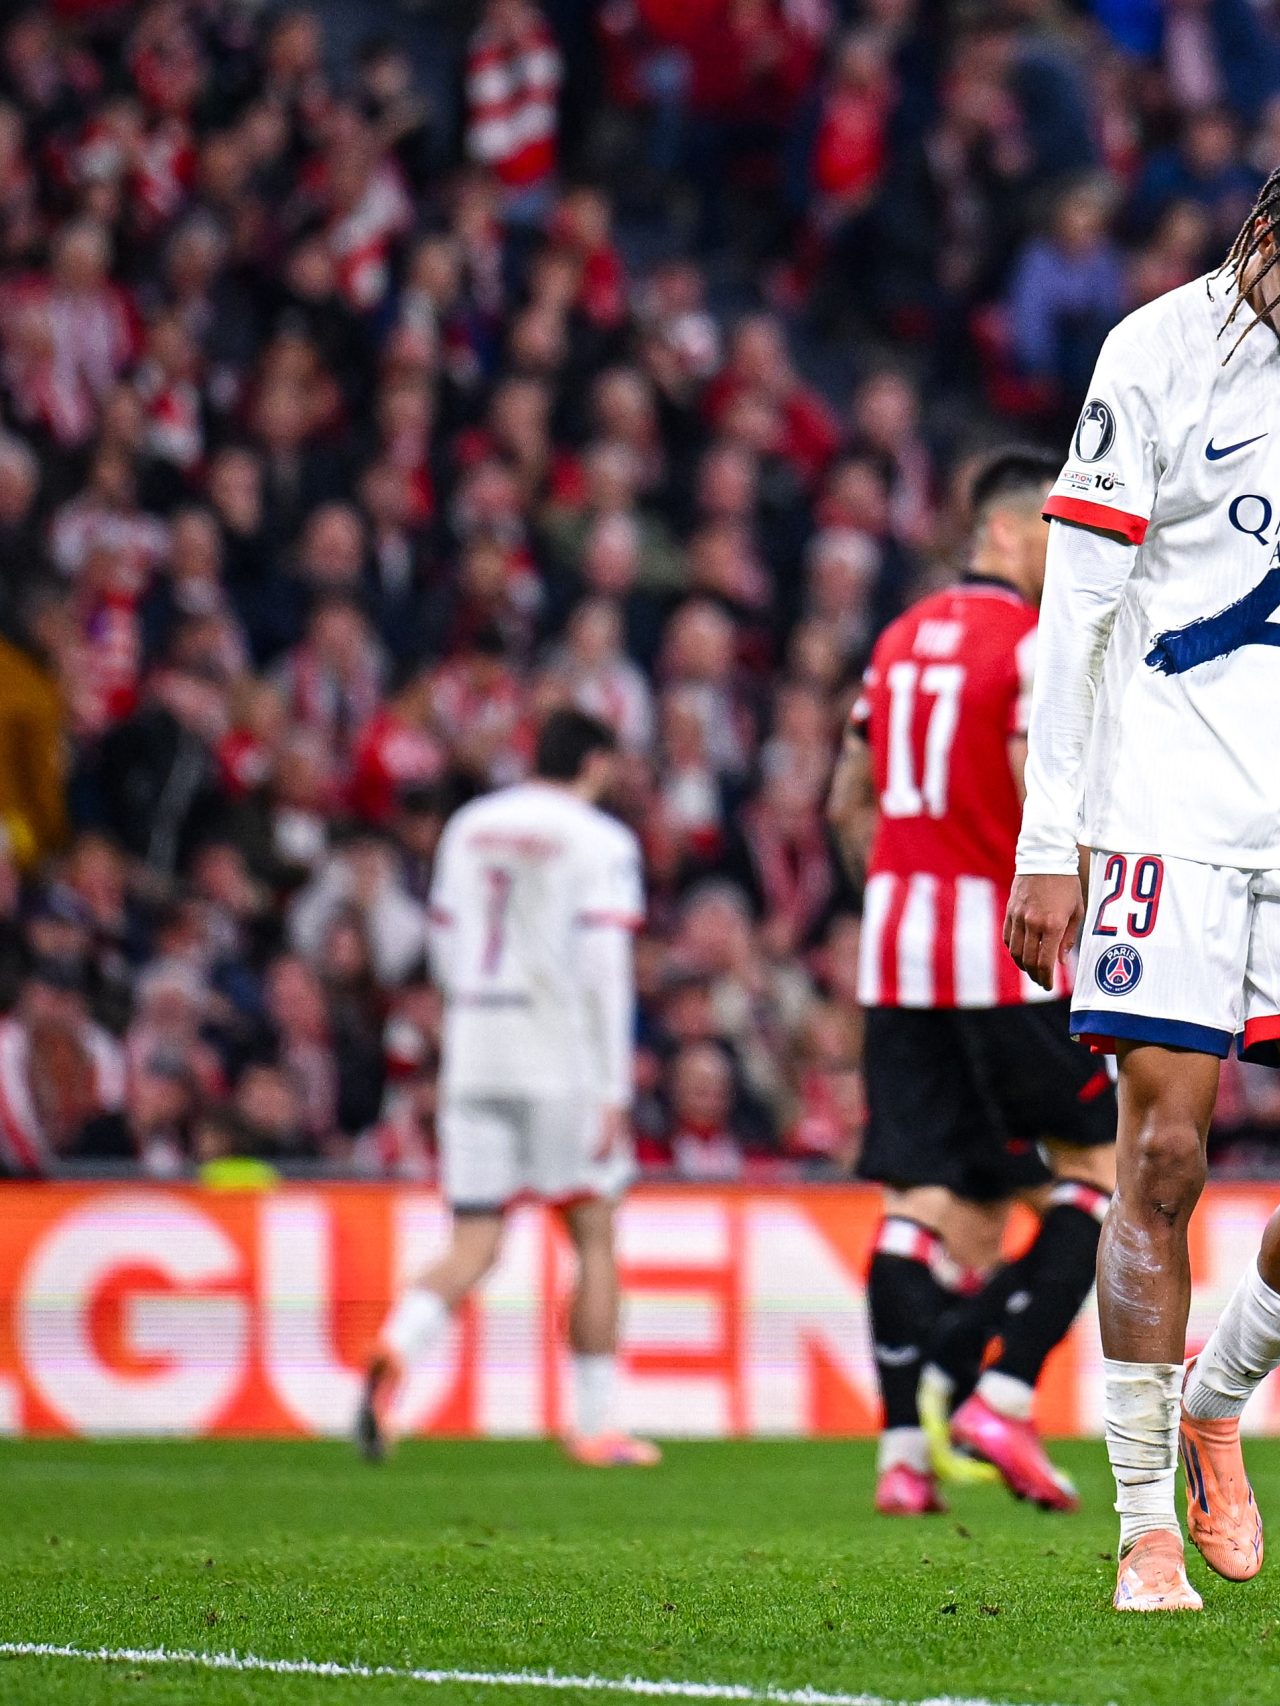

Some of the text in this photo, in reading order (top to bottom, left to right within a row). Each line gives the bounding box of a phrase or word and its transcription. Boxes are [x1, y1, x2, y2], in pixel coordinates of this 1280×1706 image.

[1095, 474, 1115, 491] 10
[881, 661, 967, 819] 17
[1092, 854, 1164, 938] 29
[1106, 947, 1136, 961] PARIS
[0, 1192, 885, 1438] GUIEN
